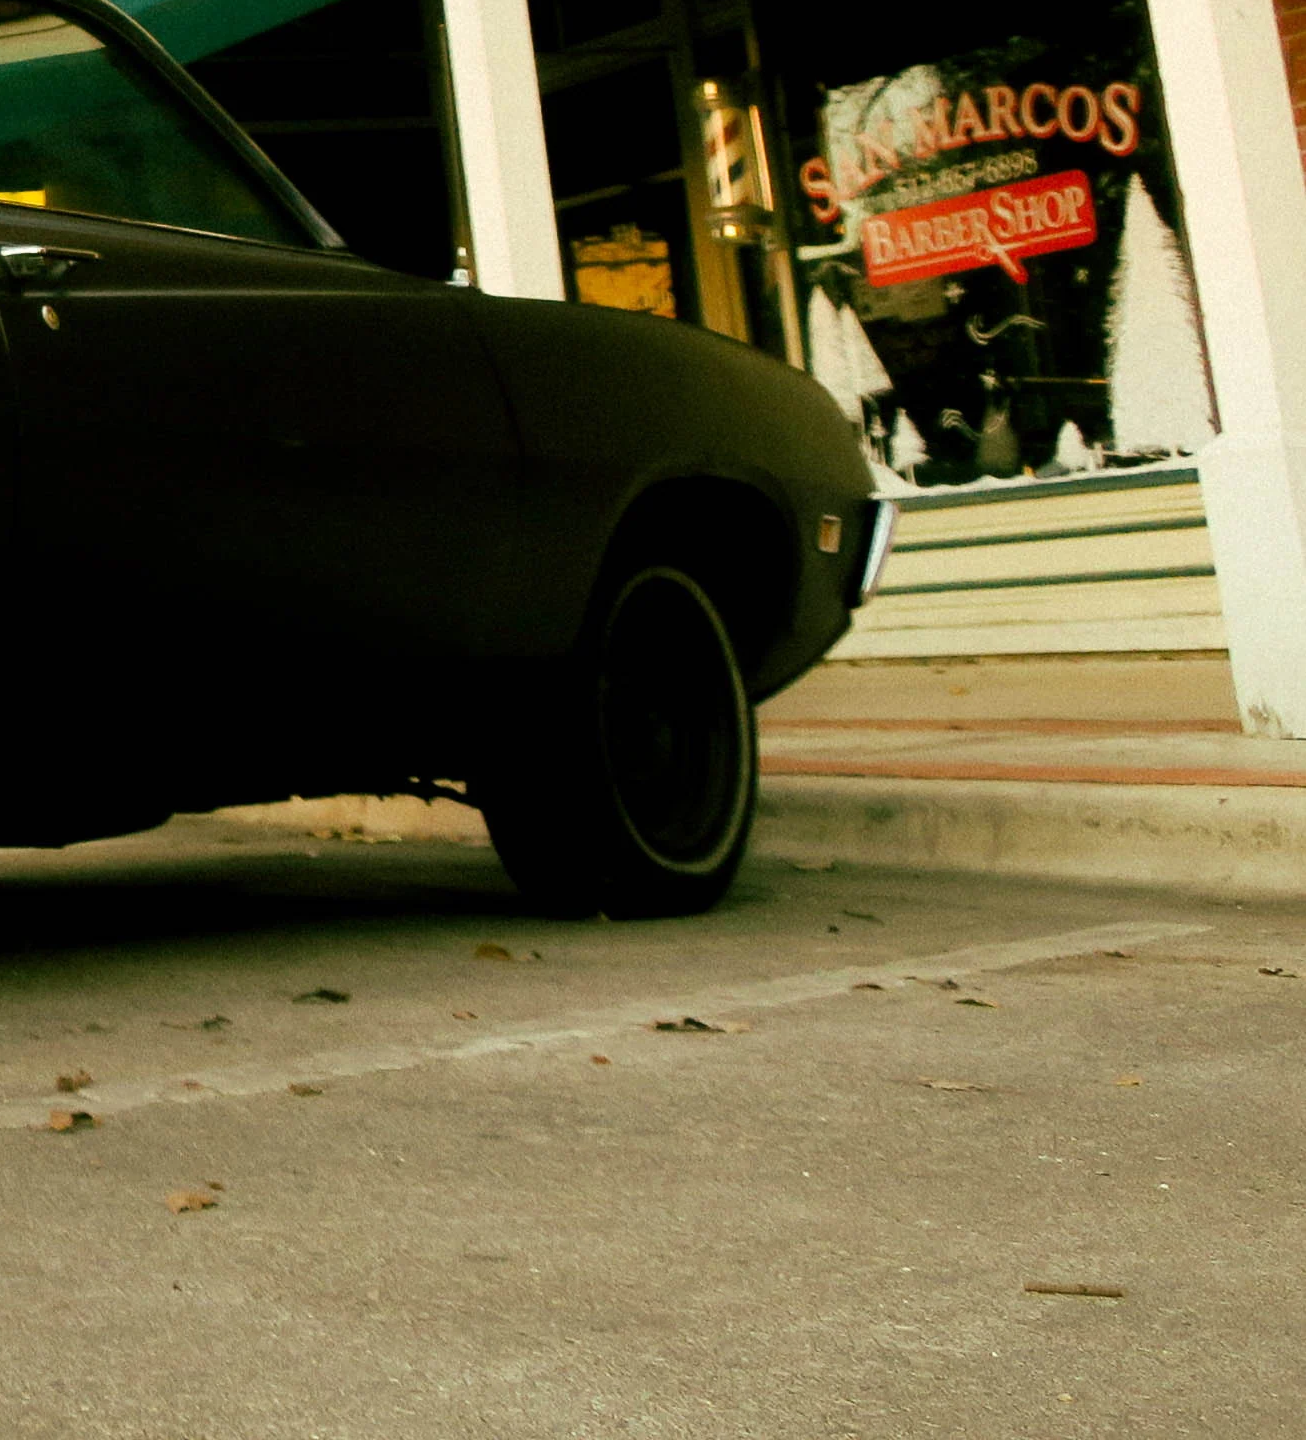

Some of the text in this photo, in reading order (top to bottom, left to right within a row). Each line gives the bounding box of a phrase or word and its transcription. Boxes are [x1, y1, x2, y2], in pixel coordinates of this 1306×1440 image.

[800, 82, 1140, 223] SAN MARCOS
[867, 185, 1086, 264] BARBER SHOP
